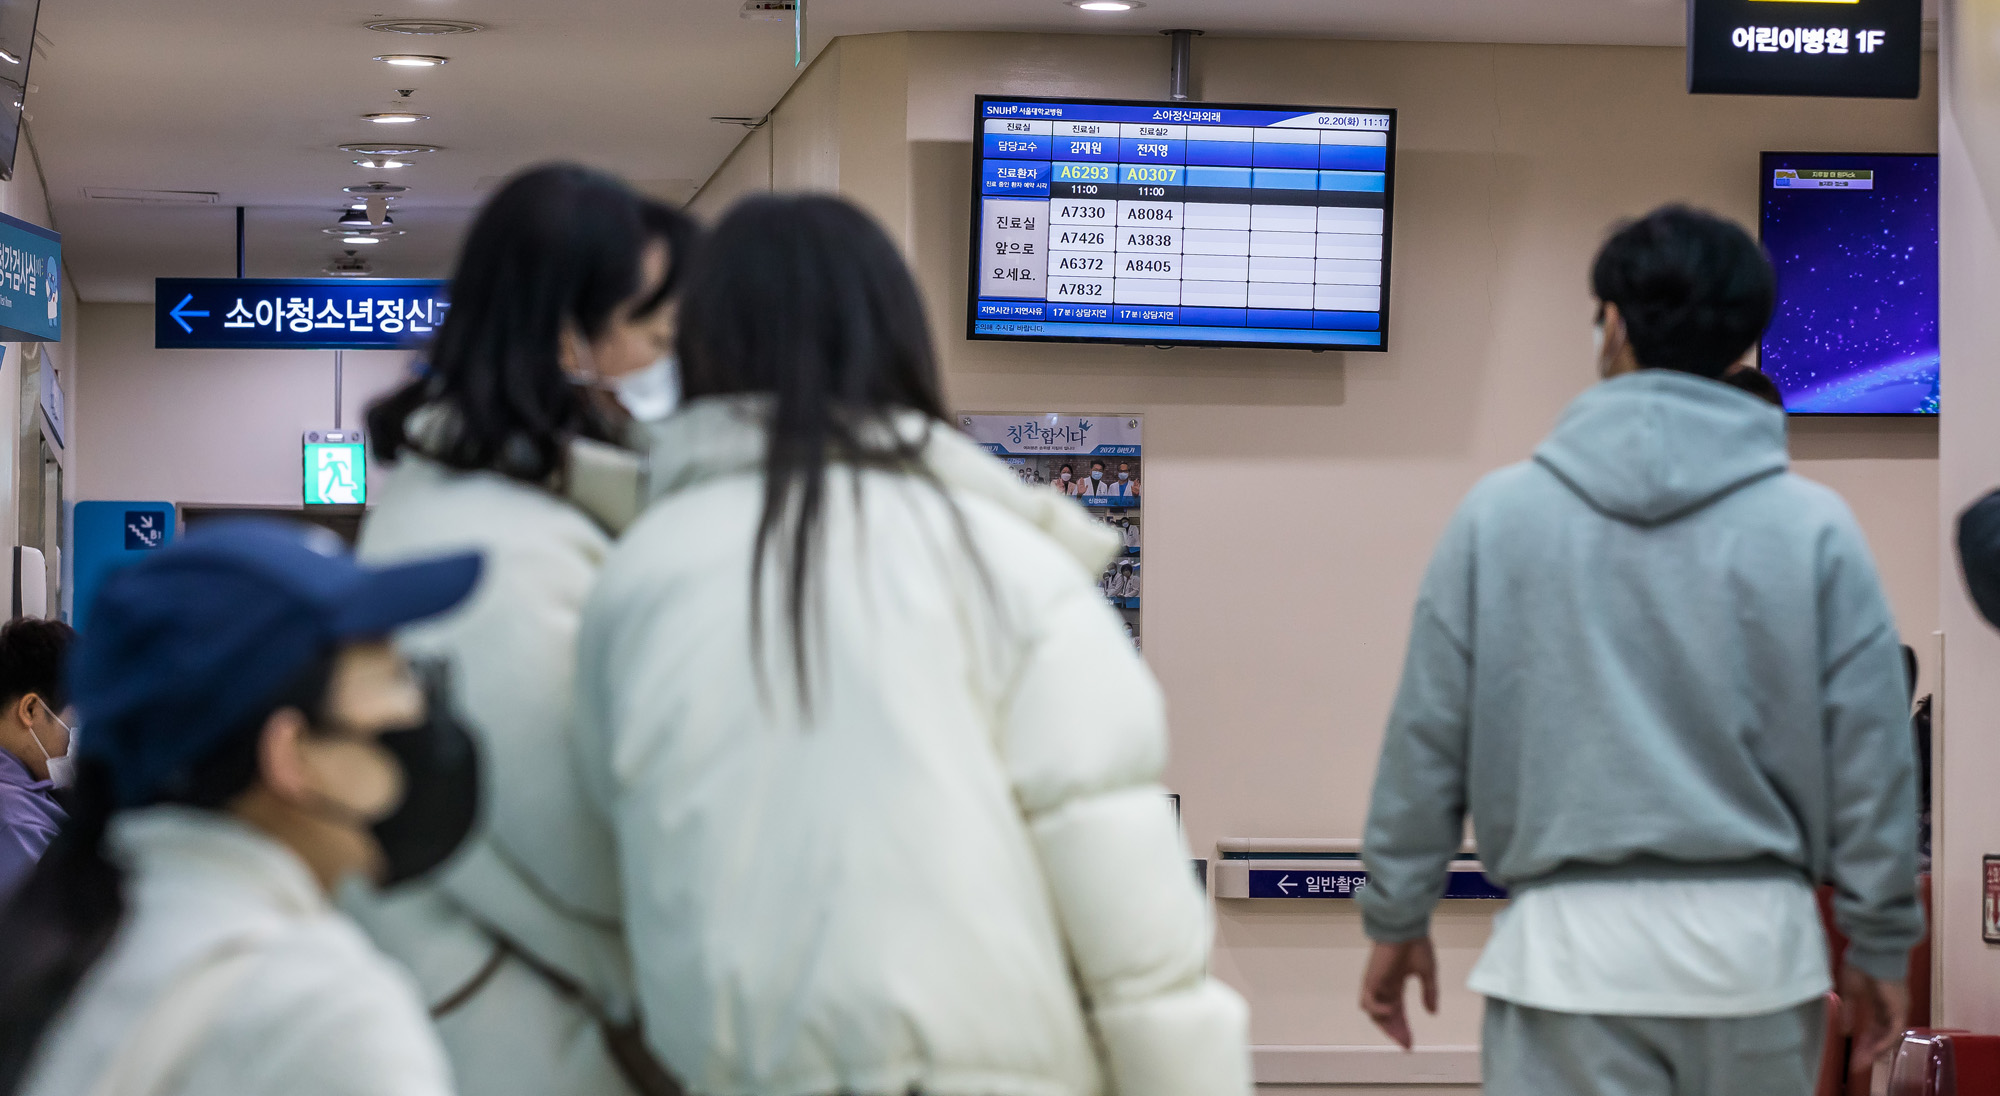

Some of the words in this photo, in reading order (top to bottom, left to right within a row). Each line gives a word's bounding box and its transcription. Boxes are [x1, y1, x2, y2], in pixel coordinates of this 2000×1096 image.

[1732, 26, 1848, 54] 어린이병원
[1856, 30, 1886, 53] 1F
[986, 106, 1012, 114] SNUH
[1019, 107, 1062, 116] 서울대학교병원
[1152, 111, 1220, 122] 소아정신과외래
[1007, 123, 1030, 131] 진료실
[1318, 116, 1359, 127] 02.20(화)
[1364, 118, 1389, 126] 11:17
[1072, 125, 1100, 134] 진료실1
[1139, 127, 1168, 136] 진료실2
[998, 141, 1037, 152] 담당교수
[1070, 142, 1102, 154] 김재원
[1137, 144, 1168, 157] 전지영
[997, 168, 1037, 179] 진료환자
[1060, 166, 1108, 180] A6293
[1127, 168, 1176, 182] A0307
[1071, 185, 1097, 194] 11:00
[1138, 187, 1164, 196] 11:00
[1061, 206, 1105, 218] A7330
[1128, 208, 1173, 220] A8084
[996, 216, 1035, 230] 진료실
[1060, 232, 1104, 244] A7426
[1128, 234, 1171, 246] A3838
[996, 242, 1034, 255] 앞으로
[1060, 258, 1103, 270] A6372
[1126, 260, 1171, 272] A8405
[993, 268, 1035, 281] 오세요.
[1059, 284, 1102, 296] A7832
[1007, 421, 1087, 446] 칭찬합시다
[1306, 876, 1366, 892] 일반촬영
